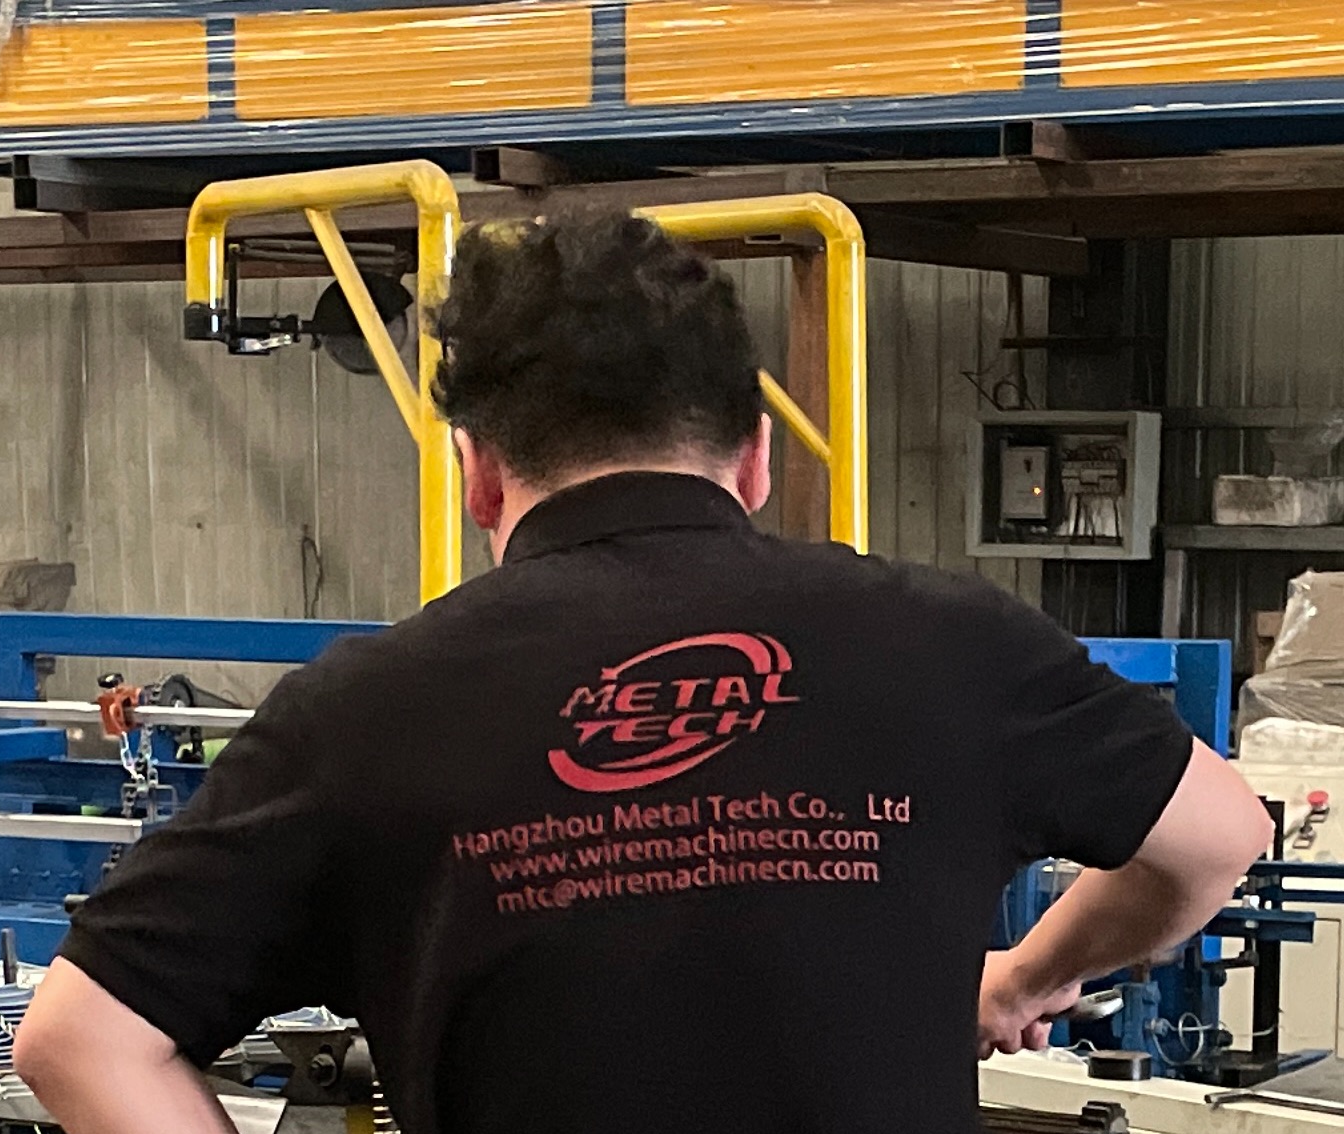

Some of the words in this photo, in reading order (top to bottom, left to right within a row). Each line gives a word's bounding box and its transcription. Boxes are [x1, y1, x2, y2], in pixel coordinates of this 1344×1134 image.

[559, 676, 801, 717] METAL
[574, 709, 766, 746] TECH
[452, 813, 604, 859] Hangzhou
[613, 796, 700, 832] Metal
[707, 791, 781, 822] Tech
[867, 793, 911, 823] Ltd
[489, 825, 881, 882] www.wiremachinecn.com
[496, 857, 881, 914] mtc@wiremachinecn.com
